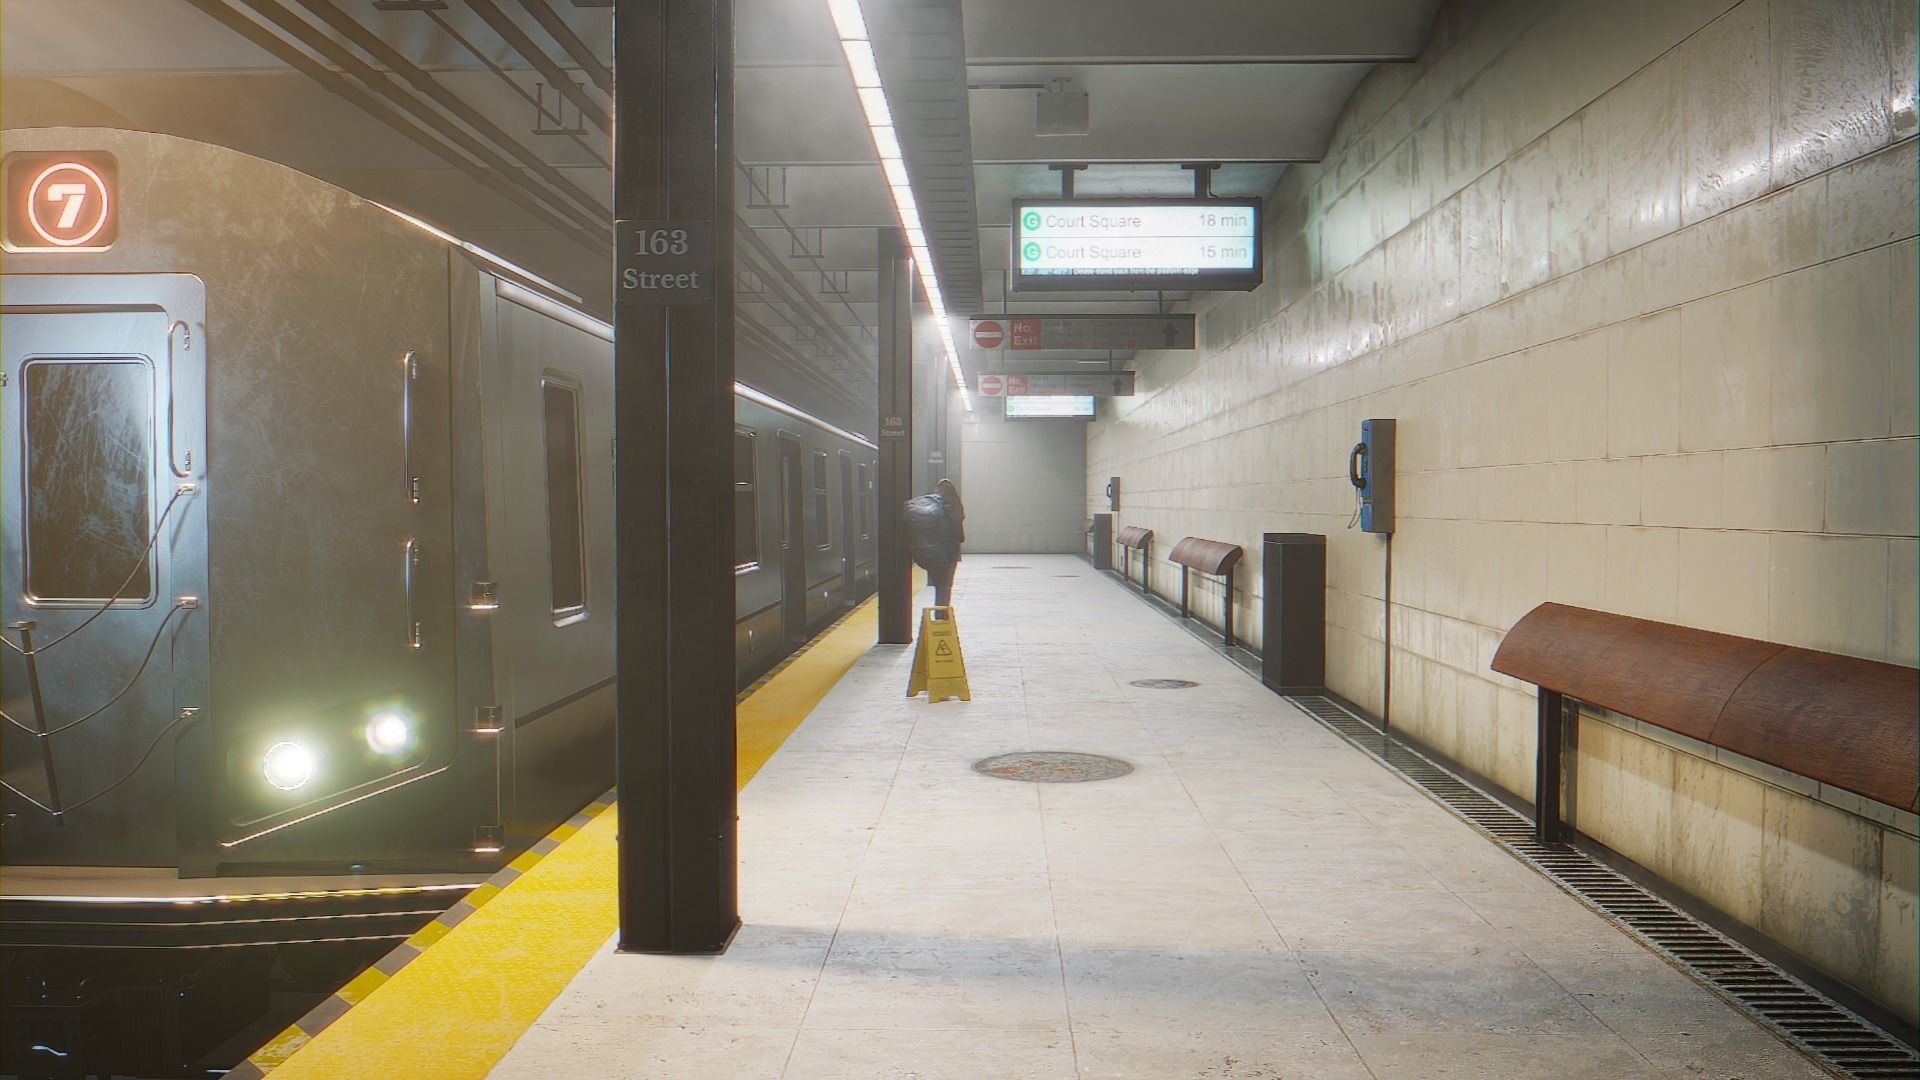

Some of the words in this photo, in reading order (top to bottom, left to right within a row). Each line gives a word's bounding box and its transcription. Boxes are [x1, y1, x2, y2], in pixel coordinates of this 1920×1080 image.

[47, 183, 86, 229] 7
[1046, 215, 1085, 228] Court
[1089, 214, 1142, 231] Square
[1199, 213, 1217, 227] 18
[1221, 213, 1247, 227] min
[634, 229, 689, 256] 163
[1046, 245, 1085, 259] Court
[1089, 245, 1142, 262] Square
[1199, 244, 1217, 258] 15
[1221, 245, 1247, 258] min
[623, 267, 700, 289] Street
[1013, 322, 1031, 334] No
[1013, 335, 1039, 346] Exit
[885, 416, 903, 427] 163
